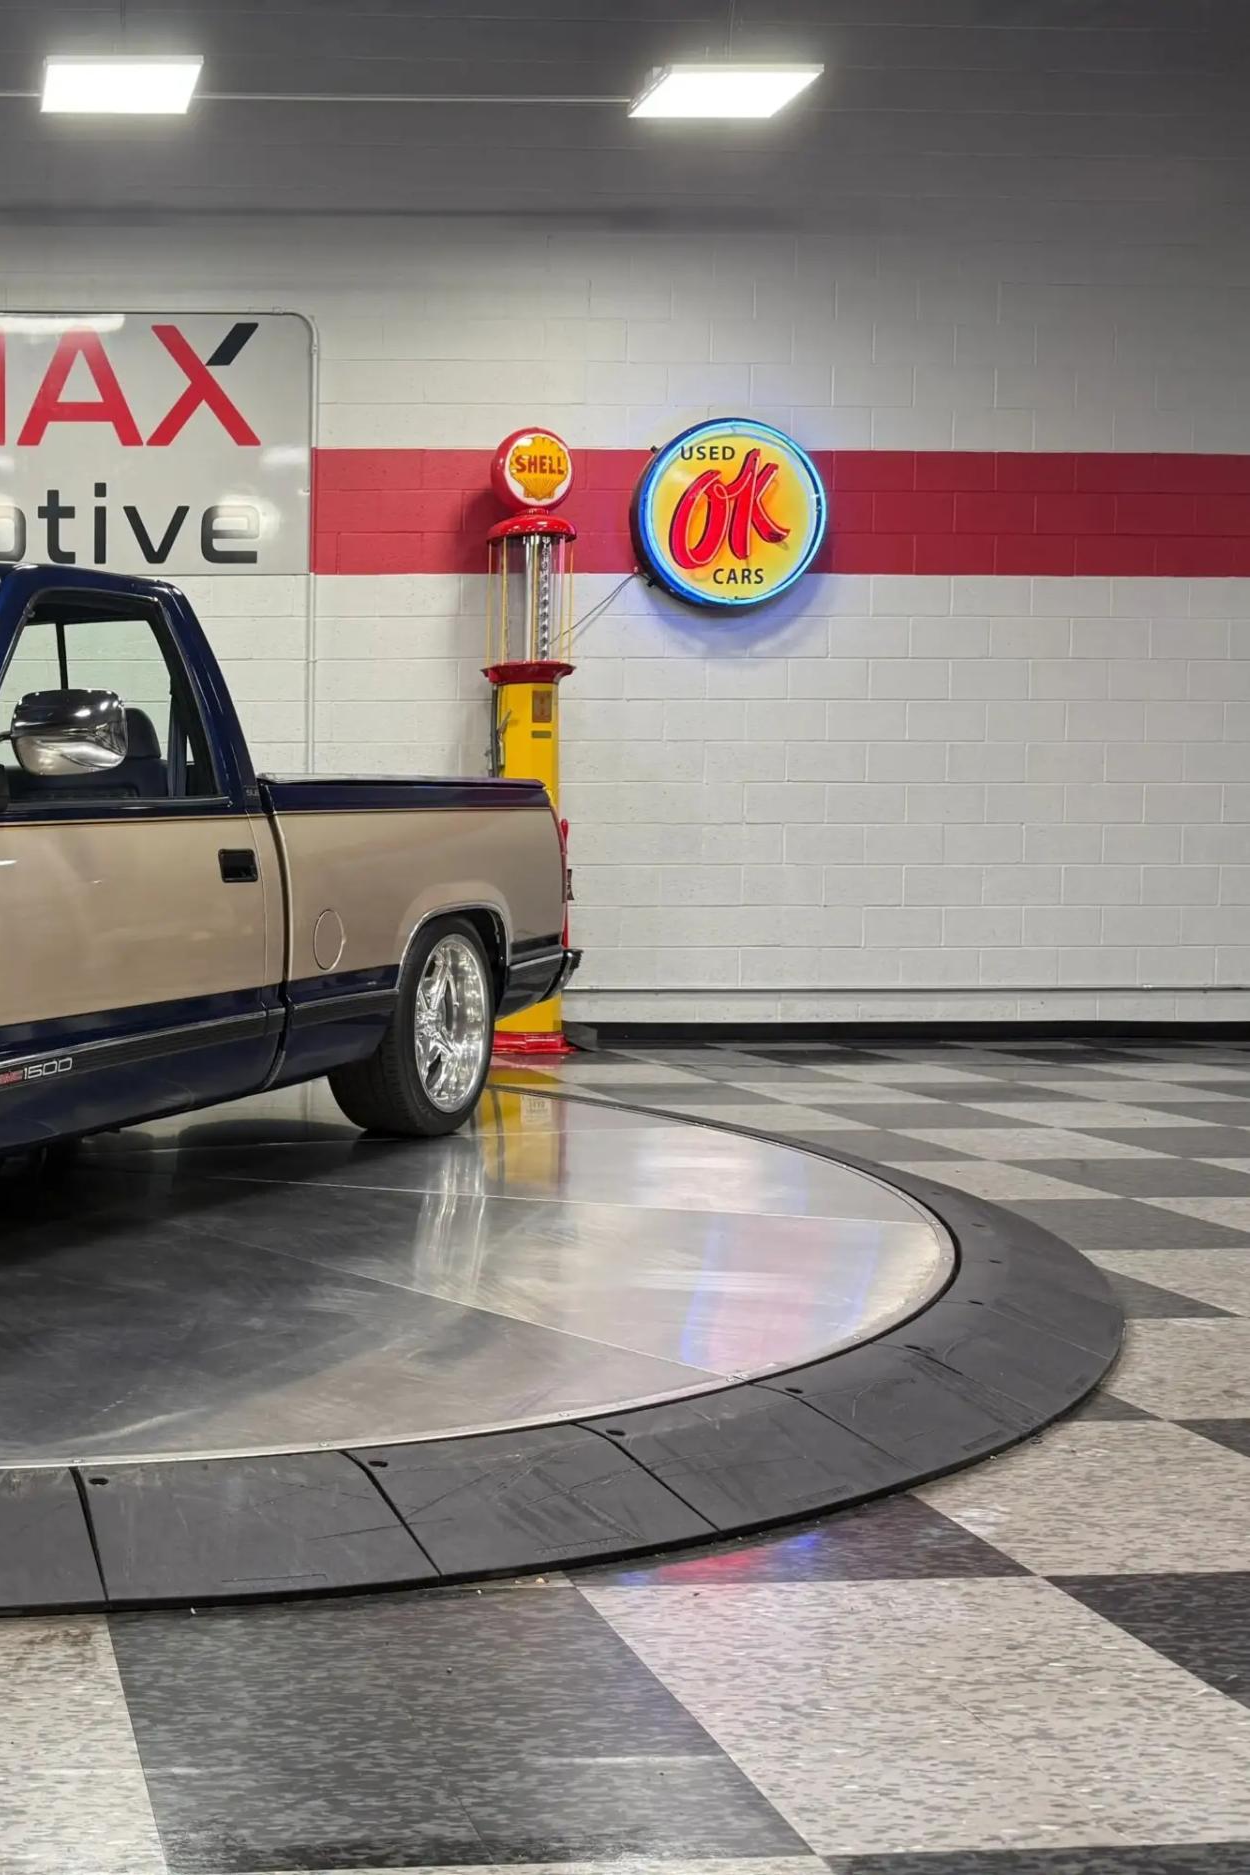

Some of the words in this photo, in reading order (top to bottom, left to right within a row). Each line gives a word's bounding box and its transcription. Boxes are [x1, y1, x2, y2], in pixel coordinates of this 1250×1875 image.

[680, 446, 735, 460] USED
[515, 455, 564, 475] SHELL
[668, 448, 790, 569] OK
[713, 568, 764, 584] CARS
[24, 1057, 73, 1080] 1500
